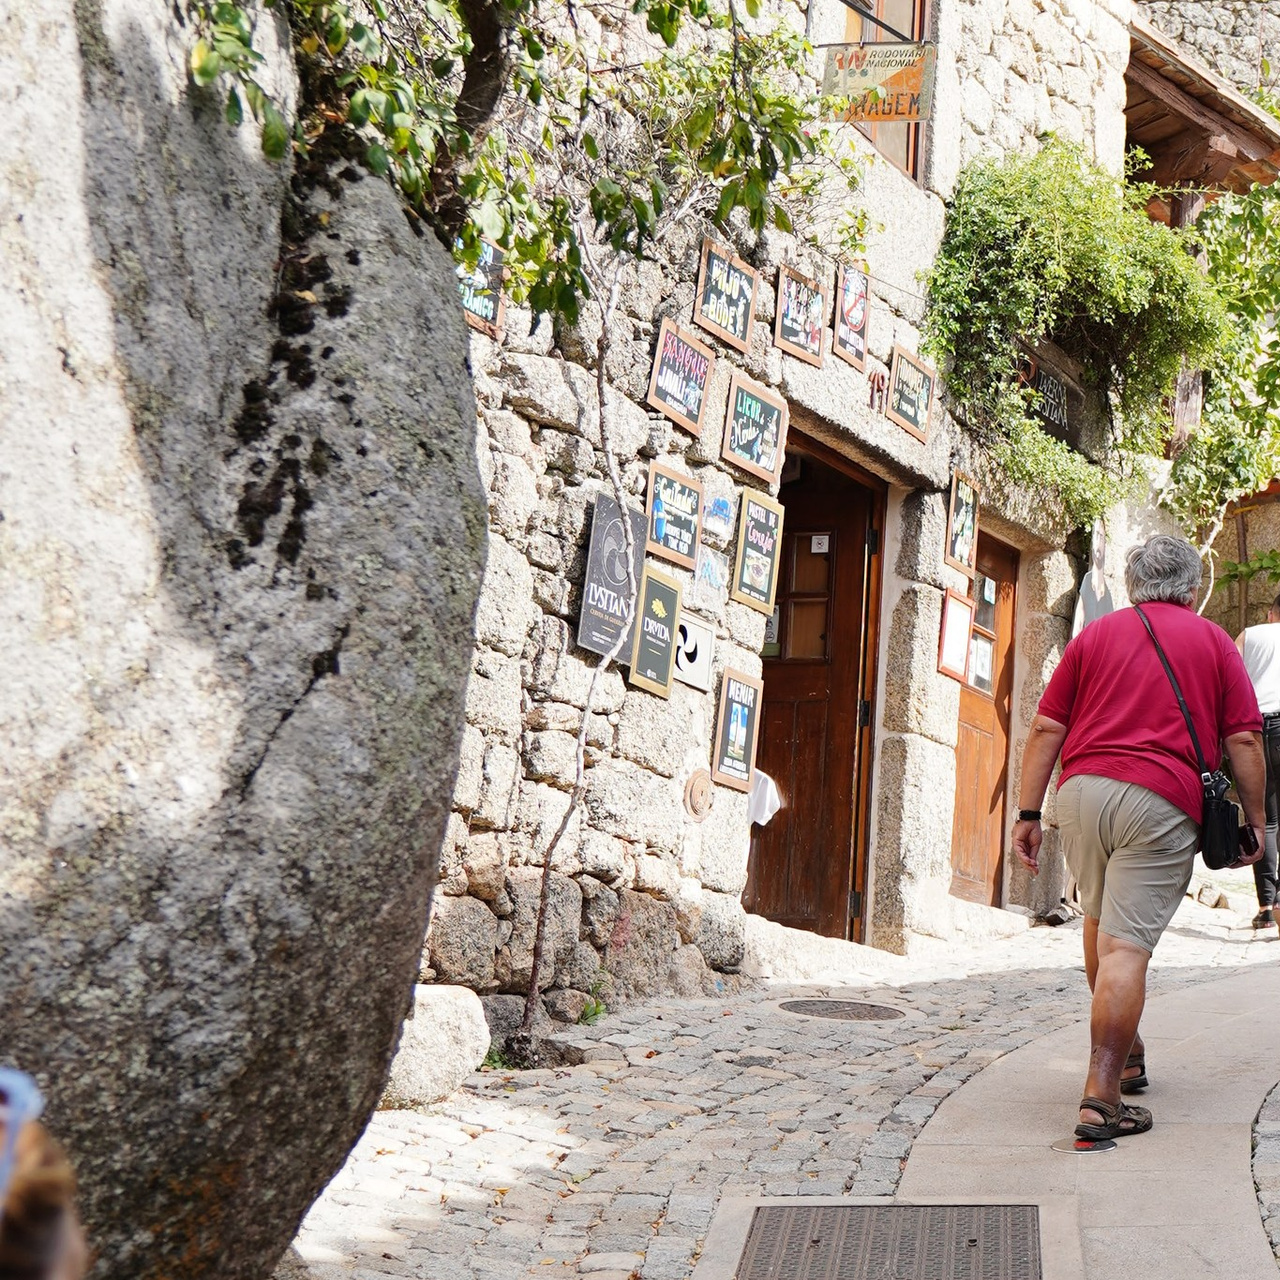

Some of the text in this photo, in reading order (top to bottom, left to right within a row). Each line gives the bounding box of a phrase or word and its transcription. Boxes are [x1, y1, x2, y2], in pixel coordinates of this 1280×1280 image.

[866, 59, 918, 68] NACIONAL
[657, 365, 687, 402] JAVALI
[588, 582, 630, 618] LVSITAN
[728, 679, 754, 708] MENIR
